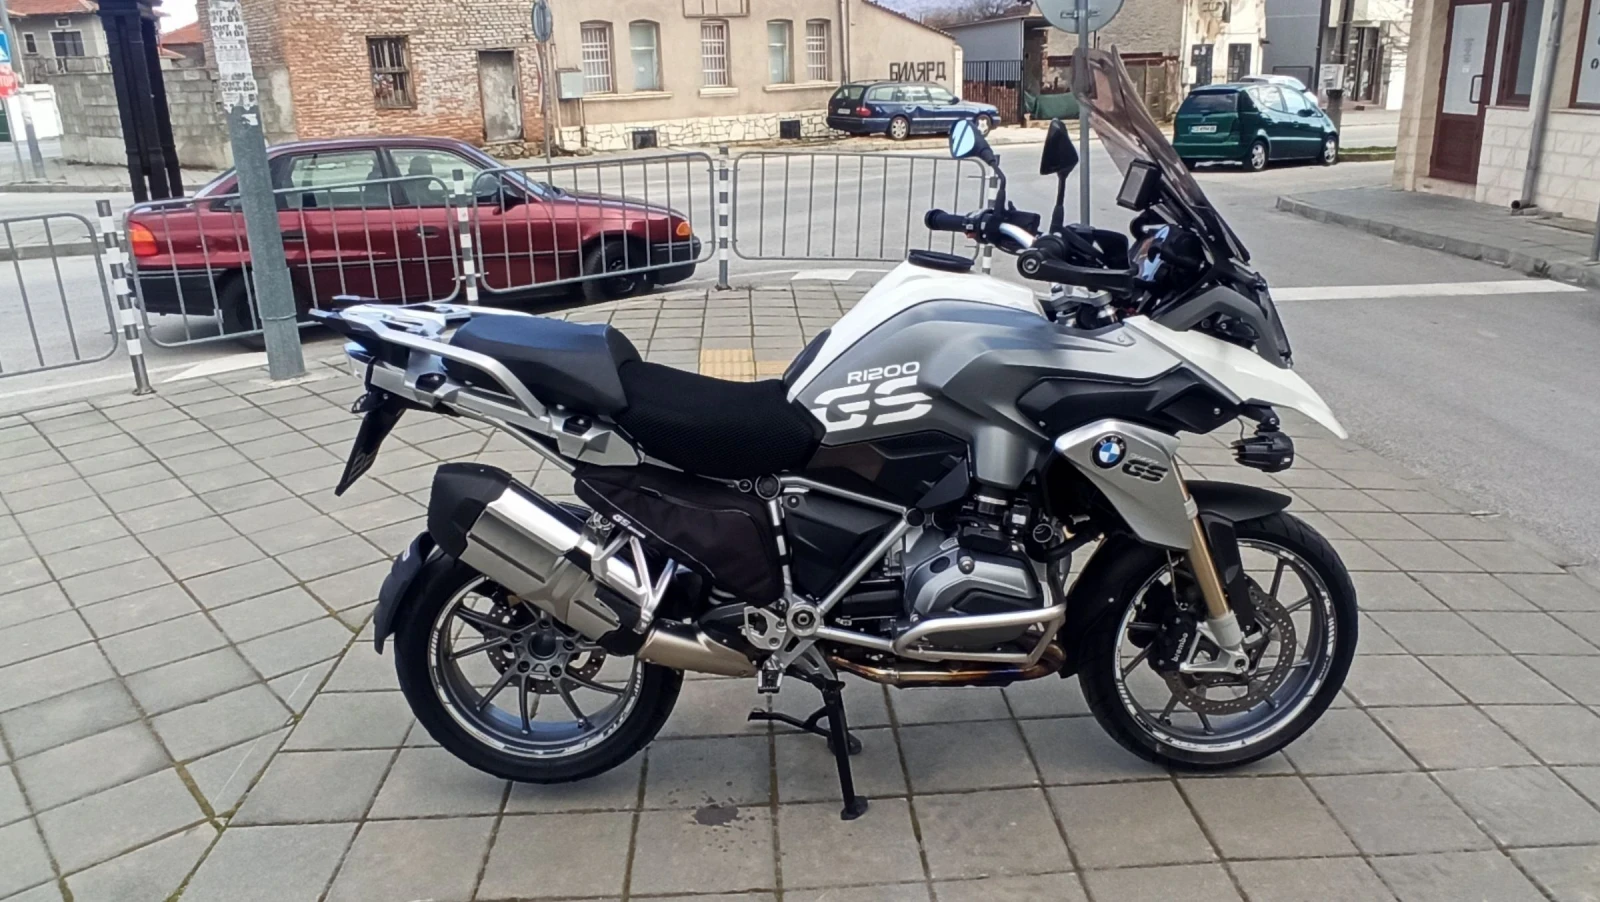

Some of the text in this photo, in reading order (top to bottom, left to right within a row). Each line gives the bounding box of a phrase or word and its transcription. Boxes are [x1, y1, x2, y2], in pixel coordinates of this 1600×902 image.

[889, 61, 947, 82] БИЛЯРД
[847, 361, 920, 385] R1200
[810, 375, 933, 433] GS
[1122, 459, 1169, 483] GS
[612, 514, 631, 527] GS
[1170, 632, 1189, 662] brembo
